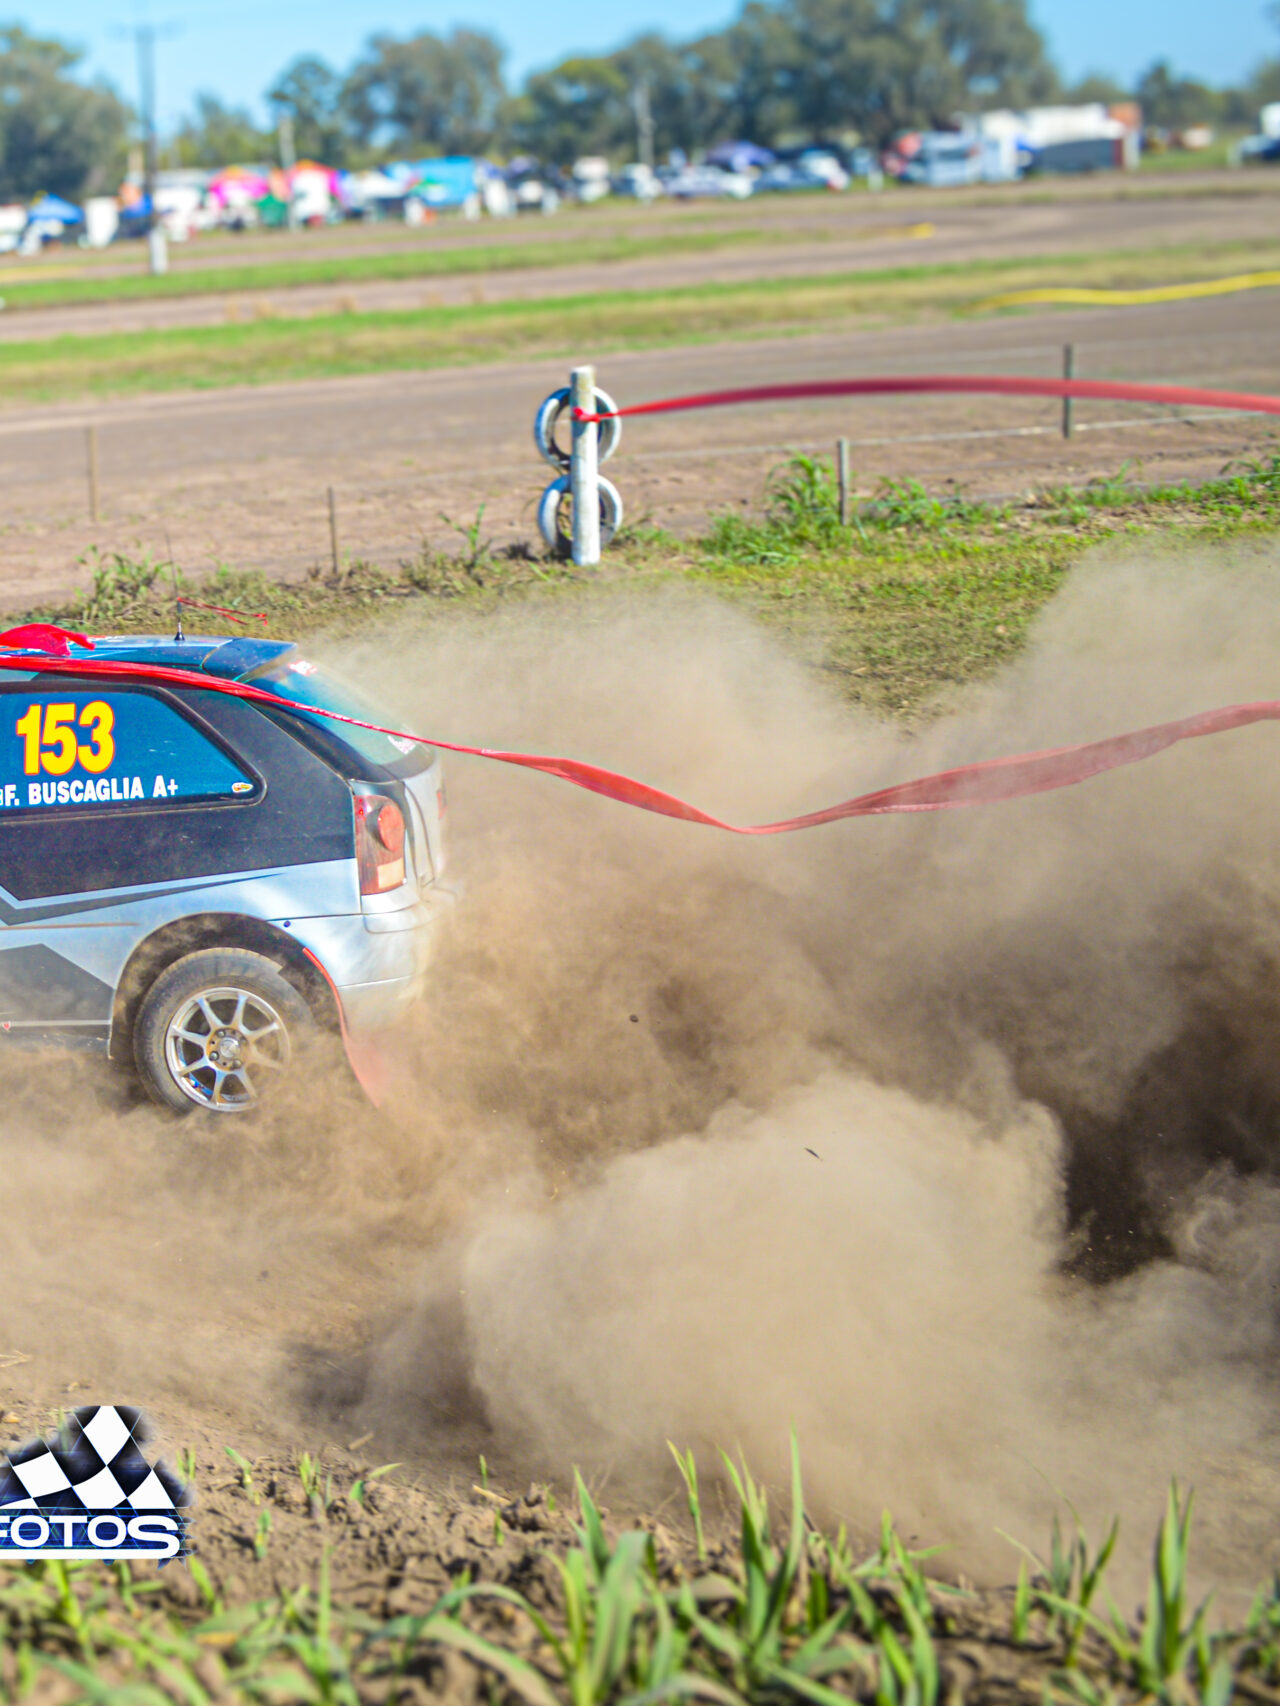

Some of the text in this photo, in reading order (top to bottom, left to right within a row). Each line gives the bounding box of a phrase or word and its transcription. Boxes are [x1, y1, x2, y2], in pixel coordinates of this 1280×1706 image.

[16, 700, 116, 776] 153
[4, 775, 178, 806] F. BUSCAGLIA A+
